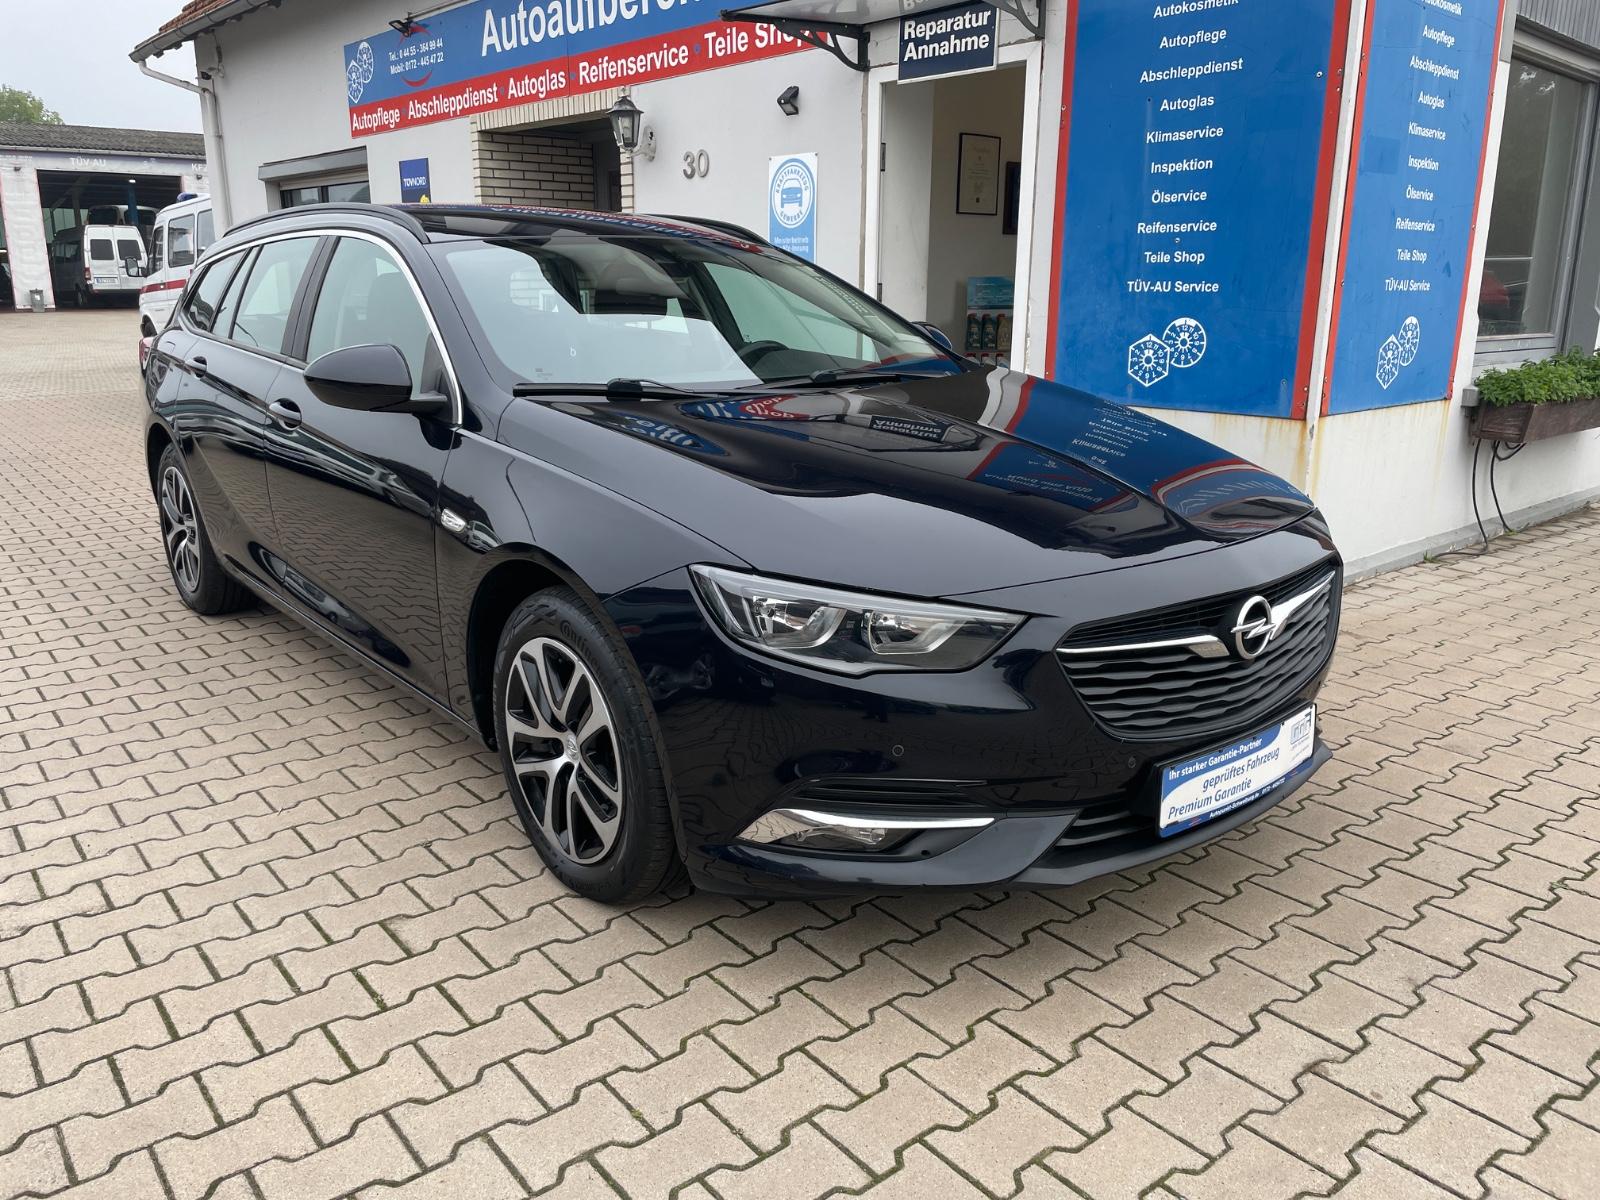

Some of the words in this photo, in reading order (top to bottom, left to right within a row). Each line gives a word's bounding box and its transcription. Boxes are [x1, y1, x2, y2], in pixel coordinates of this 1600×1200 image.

[904, 9, 992, 40] Reparatur
[1160, 29, 1227, 49] Autopflege
[1423, 24, 1455, 48] Autopflege
[903, 33, 989, 62] Annahme
[1139, 57, 1243, 83] Abschleppdienst
[1410, 55, 1460, 80] Abschleppdienst
[352, 108, 400, 131] Autopflege
[408, 83, 499, 120] Abschleppdienst
[507, 70, 566, 100] Autoglas
[579, 43, 689, 85] Reifenservice
[704, 26, 749, 59] Teile
[1160, 95, 1215, 112] Autoglas
[1418, 90, 1445, 109] Autoglas
[1146, 125, 1224, 144] Klimaservice
[1408, 121, 1447, 140] Klimaservice
[683, 149, 710, 180] 30
[1151, 158, 1213, 175] Inspektion
[1408, 155, 1439, 171] Inspektion
[1151, 189, 1207, 204] Ölservice
[1406, 184, 1434, 201] Ölservice
[1137, 220, 1217, 234] Reifenservice
[1396, 217, 1435, 232] Reifenservice
[1144, 251, 1171, 263] Teile
[1173, 250, 1205, 264] Shop
[1397, 248, 1411, 261] Teile
[1411, 250, 1427, 263] Shop
[1127, 279, 1171, 293] TÜV-AU
[1174, 280, 1219, 293] Service
[1385, 277, 1409, 291] TÜV-AU
[1409, 279, 1430, 291] Service
[1169, 770, 1180, 781] Ihr
[1181, 761, 1207, 776] starker
[1208, 738, 1263, 767] Garantie-Partner
[1202, 764, 1245, 793] geprüftes
[1246, 747, 1280, 772] Fahrzeug
[1168, 795, 1212, 820] Premium
[1214, 778, 1252, 802] Garantie
